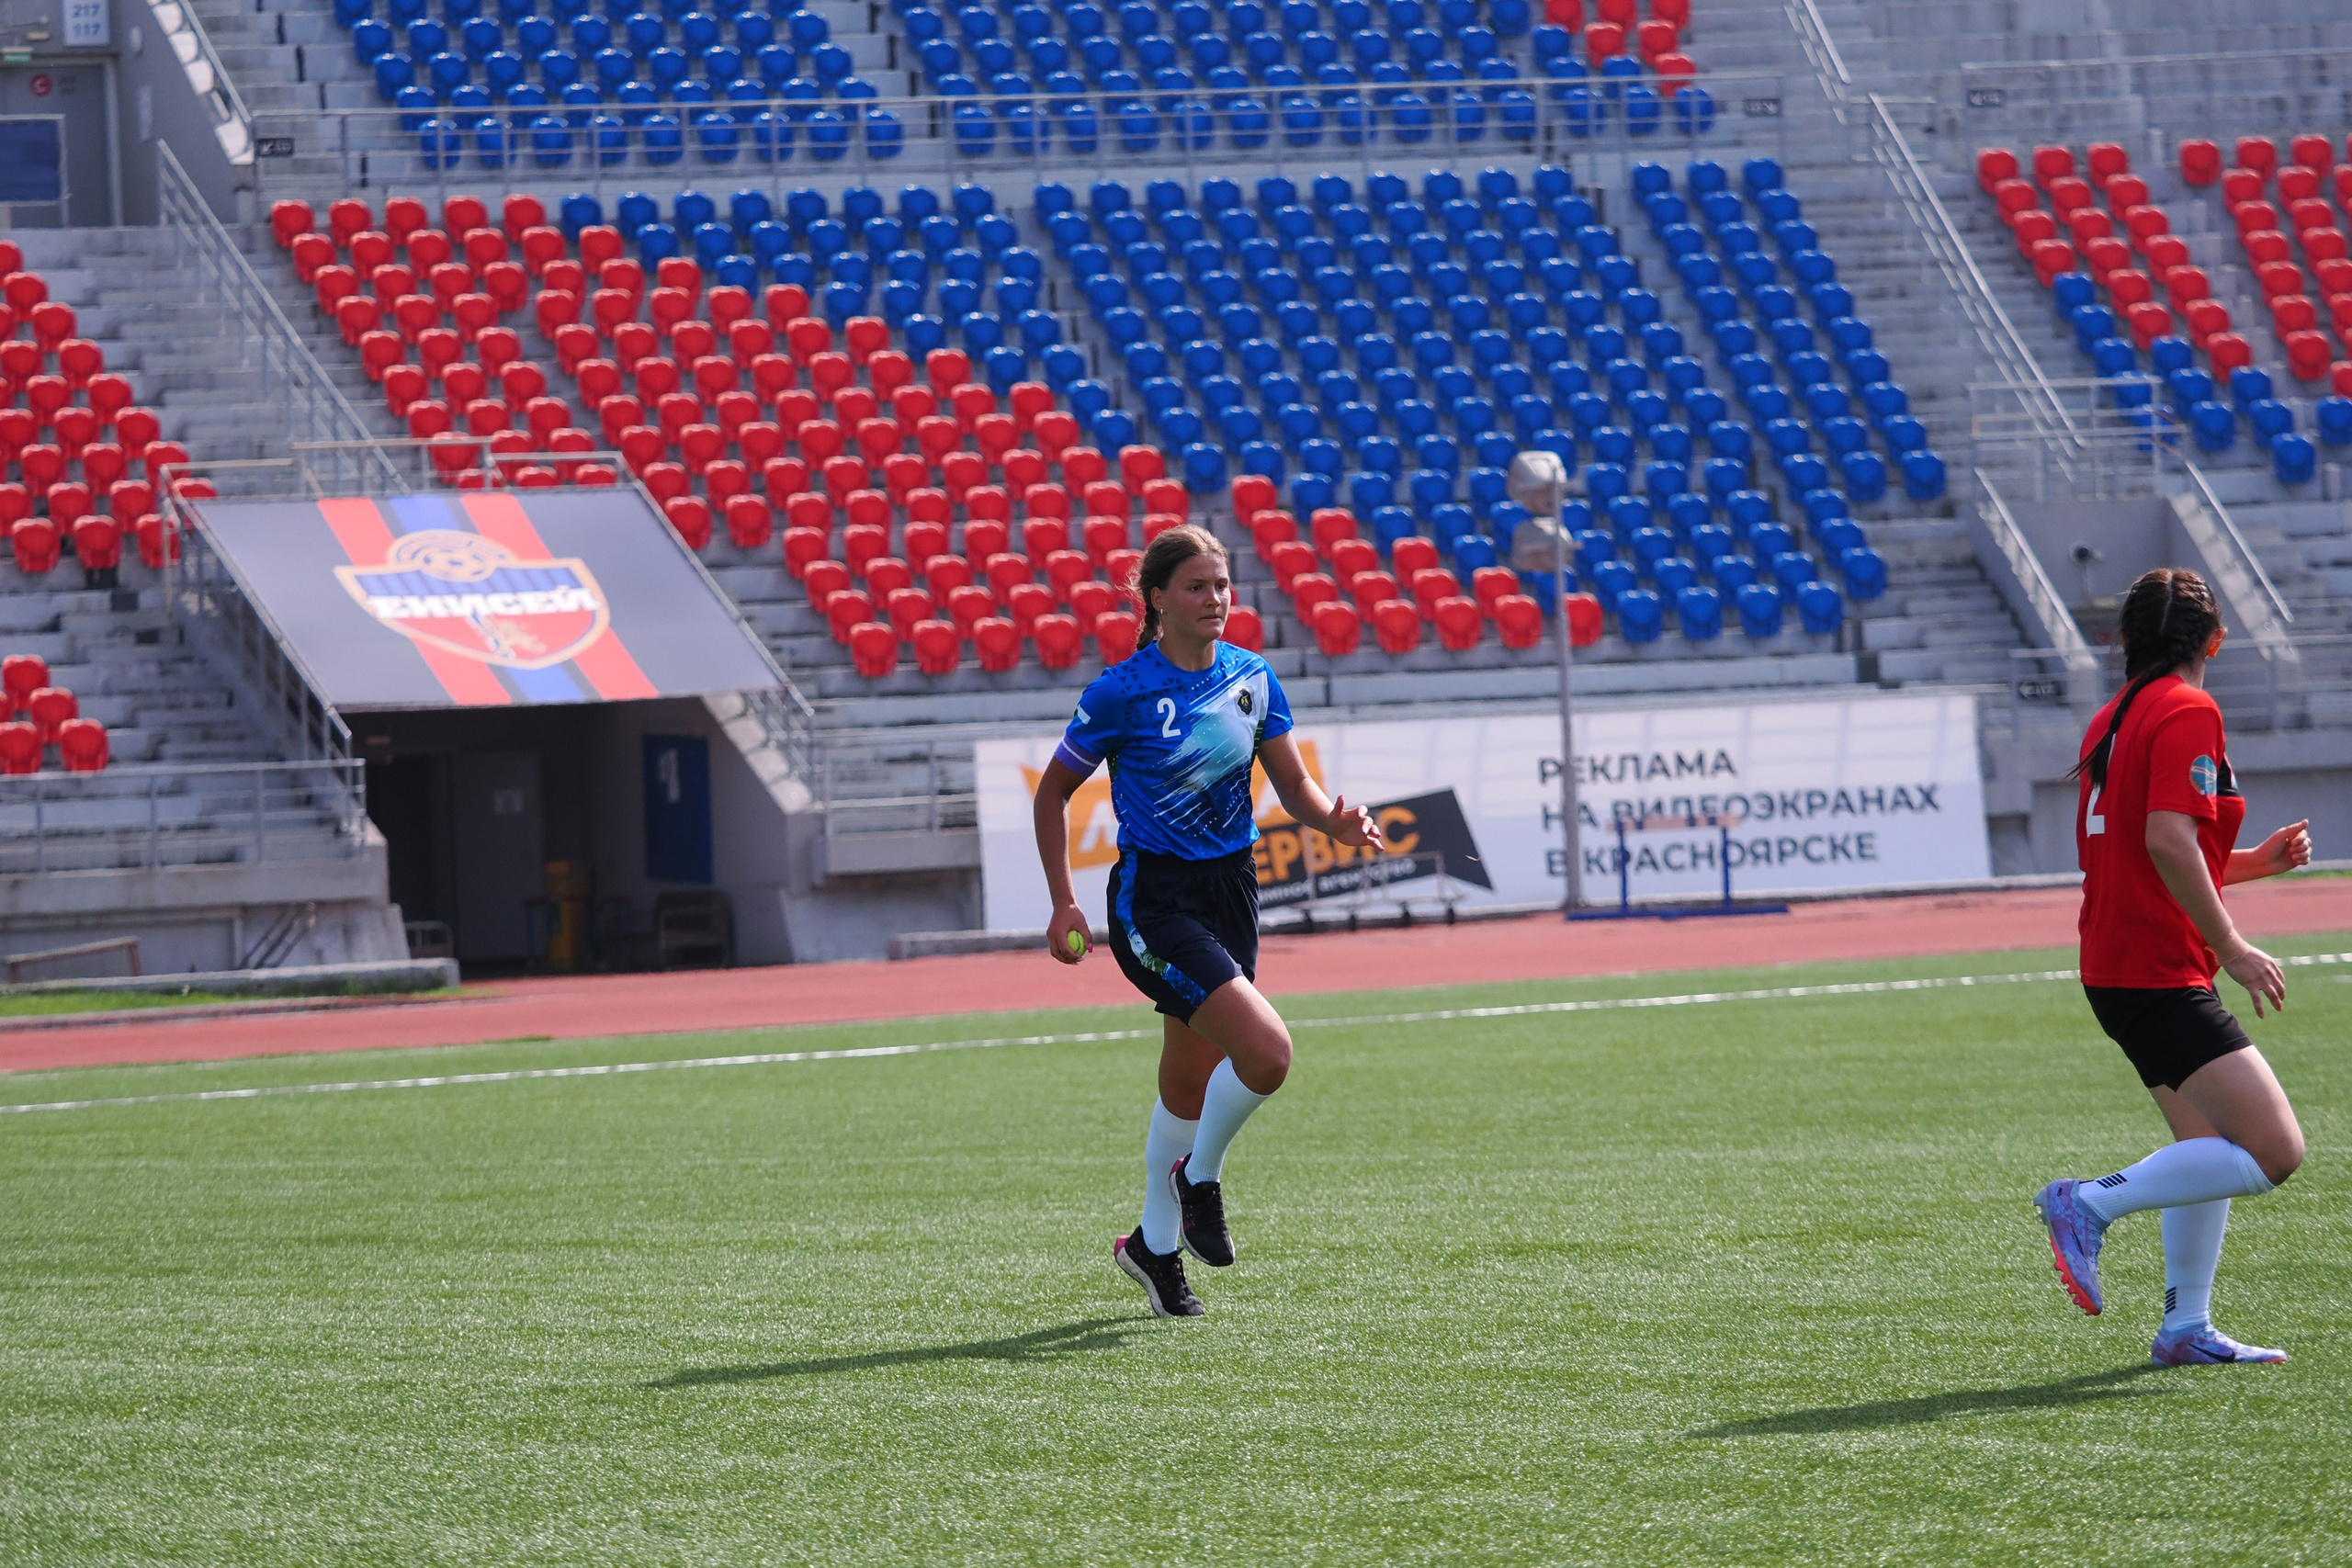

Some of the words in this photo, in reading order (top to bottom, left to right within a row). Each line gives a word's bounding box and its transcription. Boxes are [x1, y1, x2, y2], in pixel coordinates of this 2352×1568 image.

[72, 4, 101, 18] 217
[73, 22, 101, 37] 117
[1156, 696, 1182, 739] 2
[1538, 748, 1737, 785] РЕКЛАМА
[1542, 800, 1599, 831] НА
[1584, 830, 1878, 876] КРАСНОЯРСКЕ
